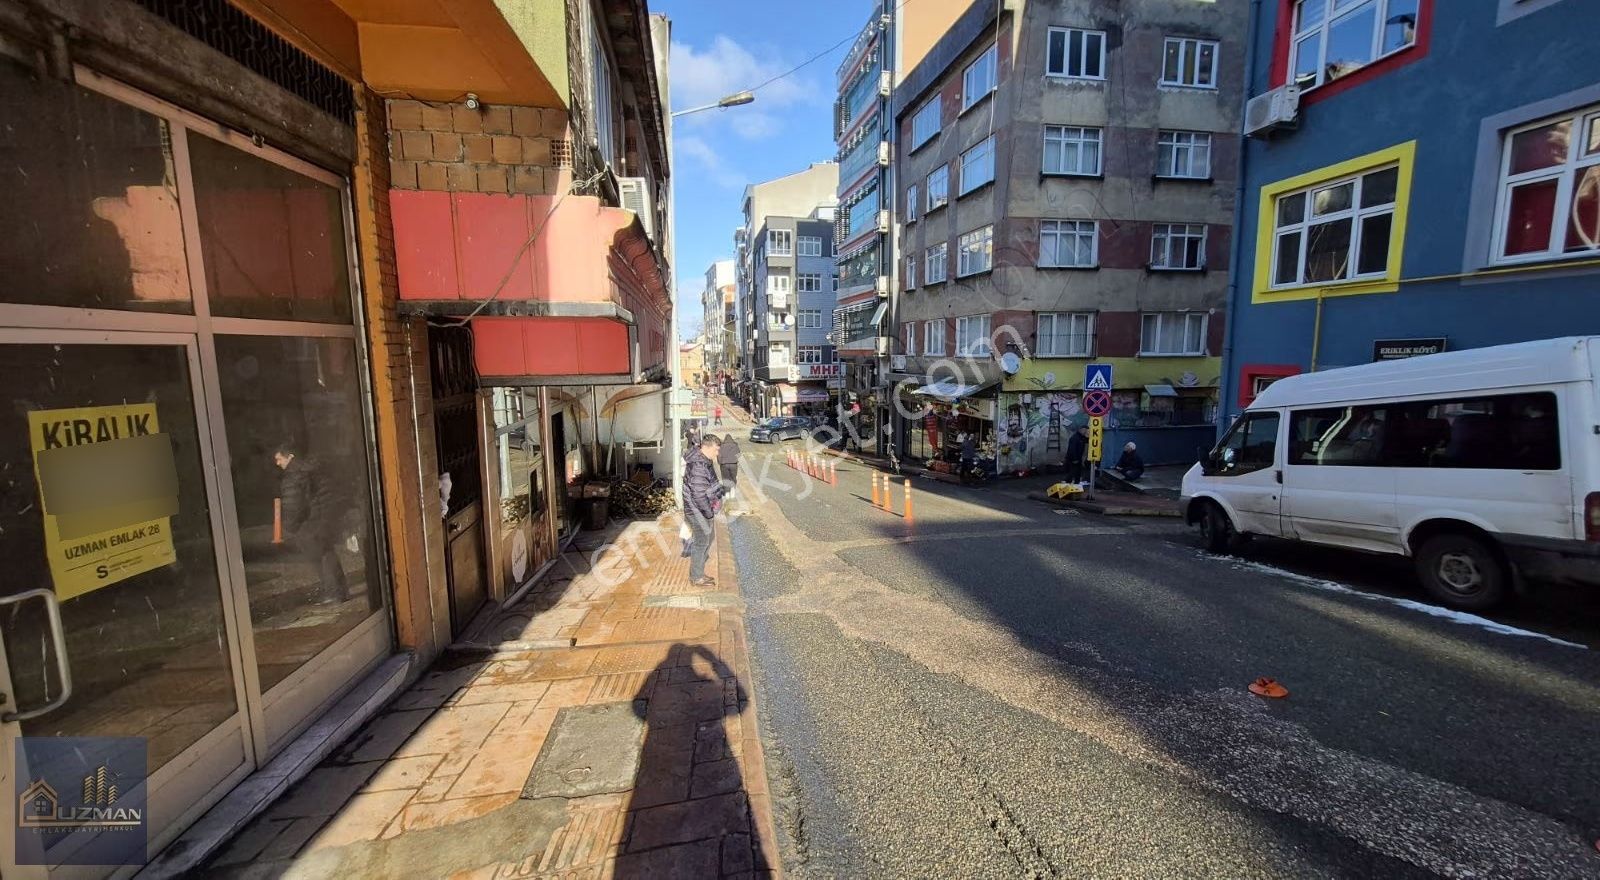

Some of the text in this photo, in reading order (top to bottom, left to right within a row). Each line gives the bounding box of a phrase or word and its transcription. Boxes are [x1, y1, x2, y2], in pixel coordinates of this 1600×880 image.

[811, 366, 839, 375] MHP
[1091, 419, 1099, 458] OKUL
[65, 540, 107, 560] UZMAN
[110, 528, 146, 546] EMLAK
